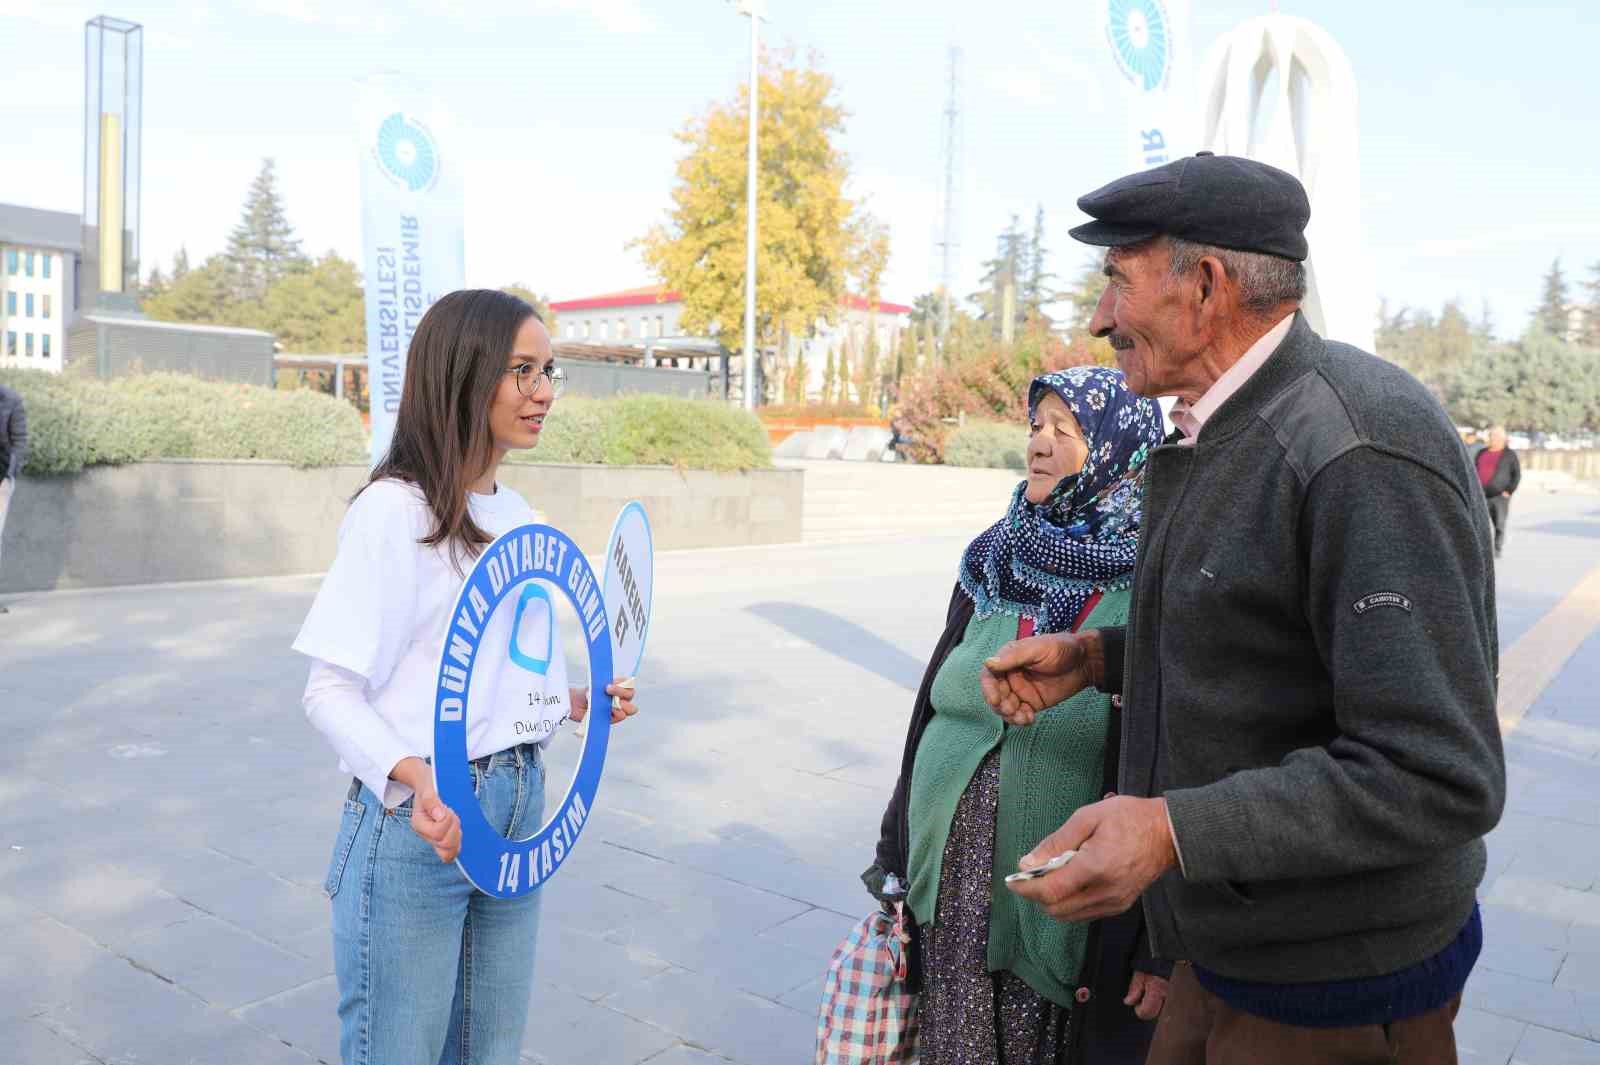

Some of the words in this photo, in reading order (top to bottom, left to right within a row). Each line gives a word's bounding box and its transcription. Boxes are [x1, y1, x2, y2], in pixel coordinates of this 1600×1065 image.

[440, 585, 490, 722] DÜNYA
[486, 532, 568, 596] DİYABET
[567, 558, 607, 643] GÜNÜ
[613, 535, 647, 640] HAREKET
[614, 604, 629, 649] ET
[497, 852, 520, 893] 14
[528, 792, 587, 888] KASIM
